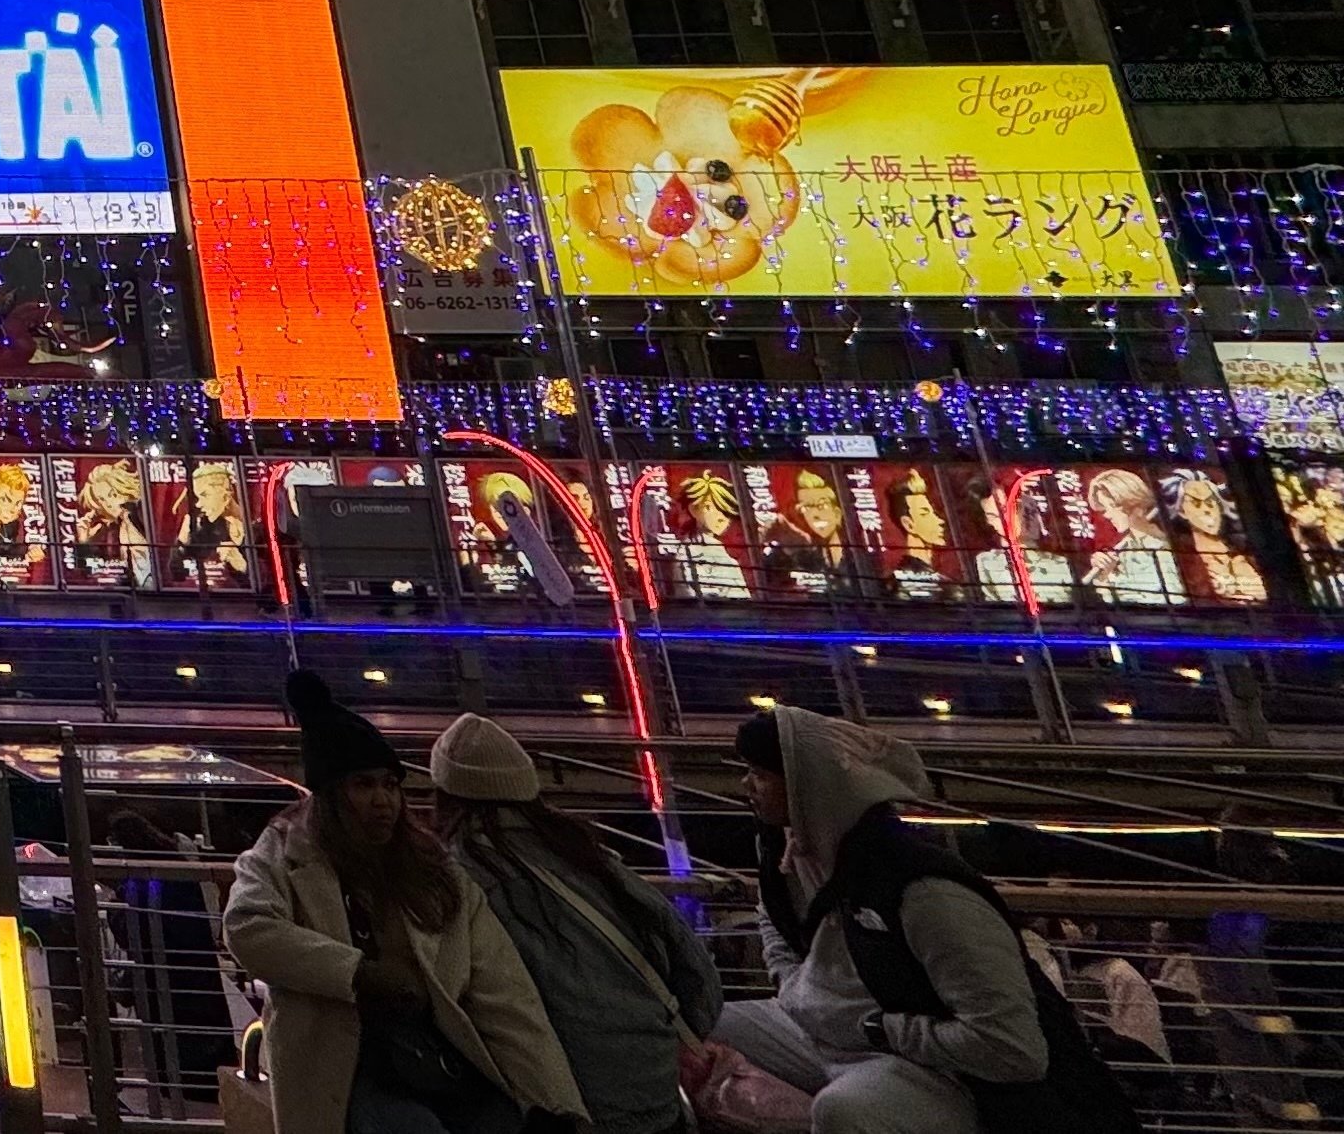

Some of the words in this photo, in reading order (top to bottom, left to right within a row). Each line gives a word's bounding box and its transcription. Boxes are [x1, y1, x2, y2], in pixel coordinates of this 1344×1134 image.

[958, 75, 1047, 115] Hana
[836, 154, 981, 183] 大阪土産
[918, 192, 1136, 240] 花ラング
[350, 502, 410, 514] information
